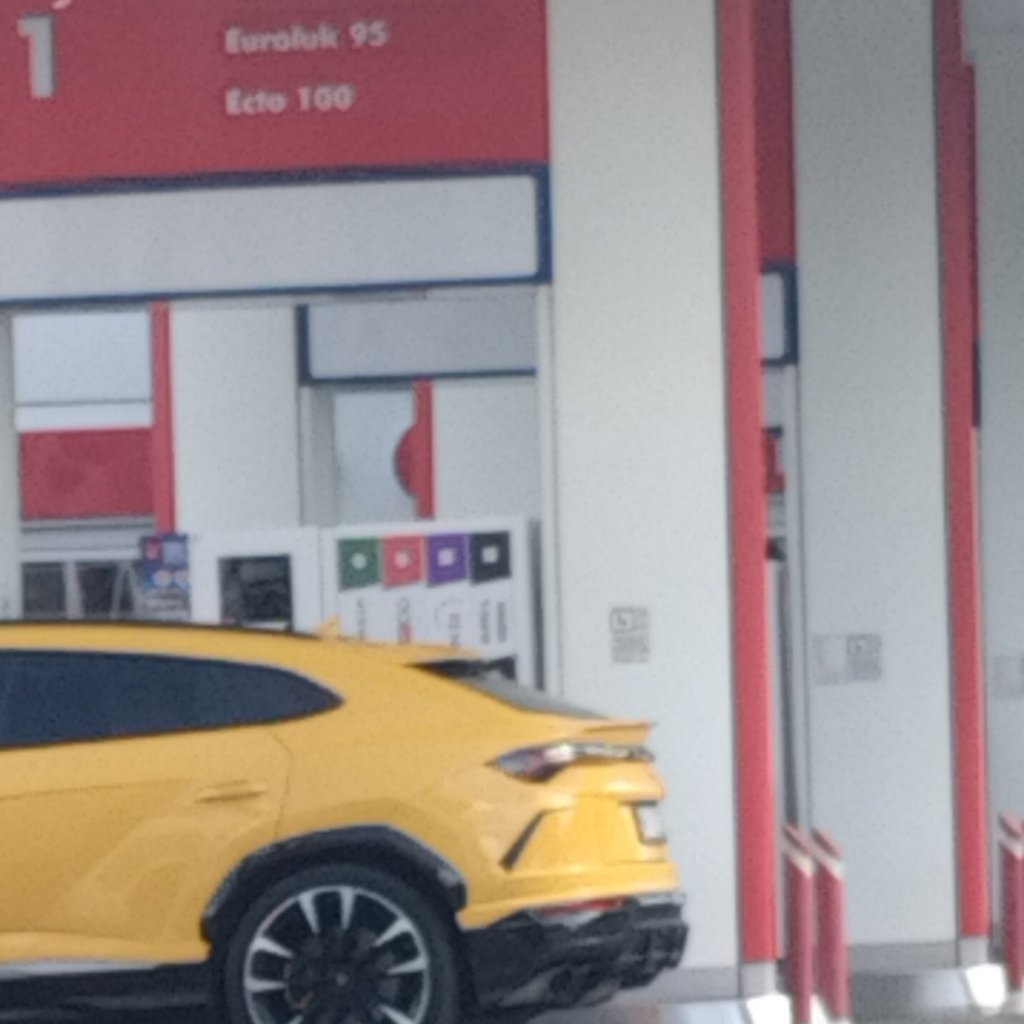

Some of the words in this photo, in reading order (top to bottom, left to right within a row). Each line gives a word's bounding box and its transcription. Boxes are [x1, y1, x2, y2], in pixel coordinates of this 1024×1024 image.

[349, 20, 389, 47] 95
[17, 14, 54, 99] 1
[226, 86, 287, 115] Ecto
[298, 83, 355, 111] 100
